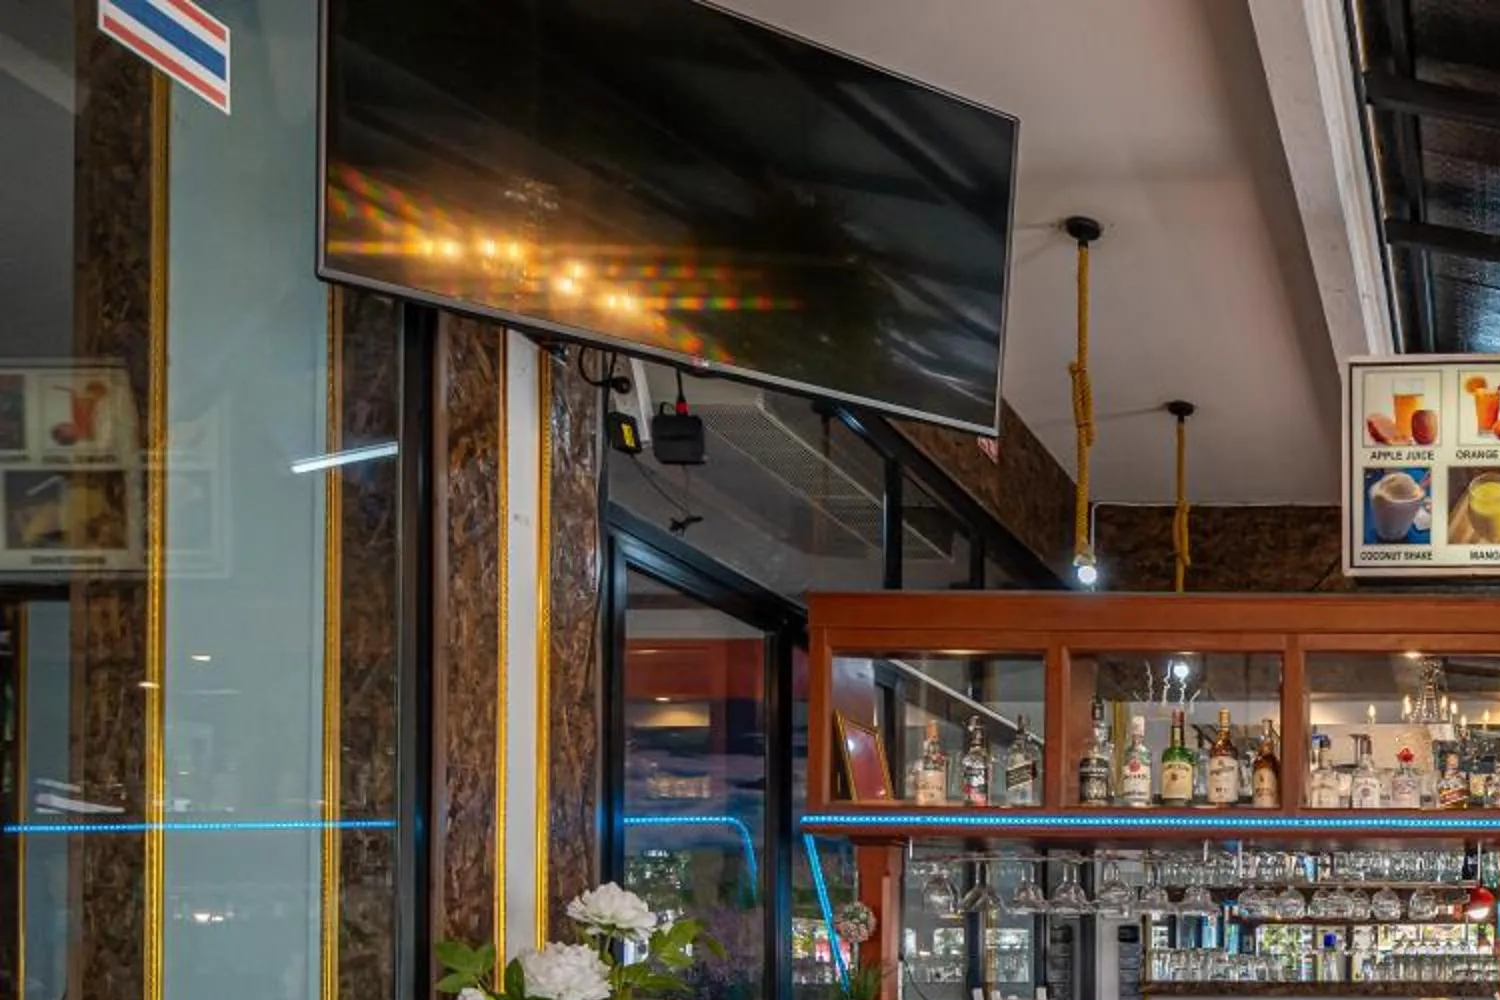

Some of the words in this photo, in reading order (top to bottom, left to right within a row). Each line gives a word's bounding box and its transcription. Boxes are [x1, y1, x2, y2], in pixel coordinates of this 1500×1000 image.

[1370, 450, 1403, 461] APPLE
[1406, 449, 1434, 460] JUICE
[1456, 449, 1499, 460] ORANGE
[1360, 551, 1402, 561] COCONUT
[1404, 551, 1433, 560] SHAKE
